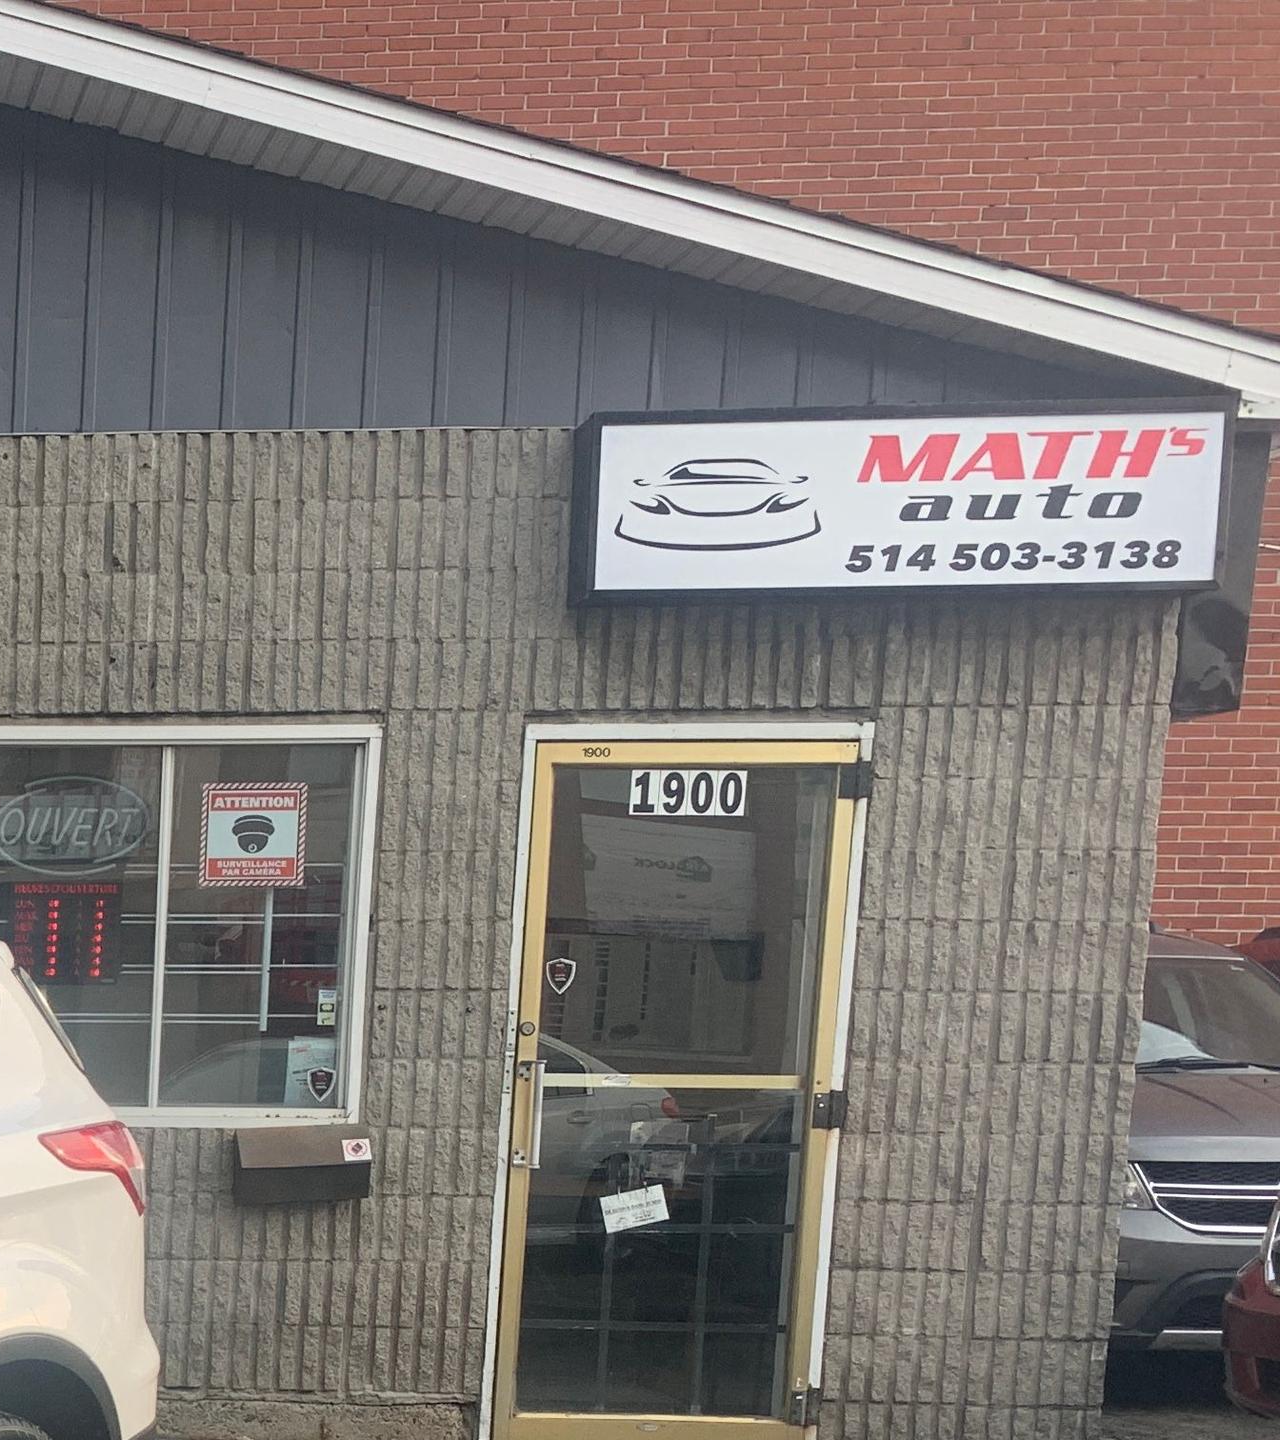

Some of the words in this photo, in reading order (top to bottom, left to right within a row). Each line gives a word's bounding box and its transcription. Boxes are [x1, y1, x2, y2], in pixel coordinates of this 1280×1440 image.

[899, 484, 1142, 521] auto
[845, 544, 936, 573] 514
[949, 539, 1182, 572] 503-3138
[583, 747, 611, 757] 1900
[213, 797, 295, 809] ATTENTION
[632, 771, 743, 814] 1900
[0, 807, 139, 846] OUVERT
[217, 860, 288, 868] SURVEILLANCE
[222, 868, 240, 876] PAR
